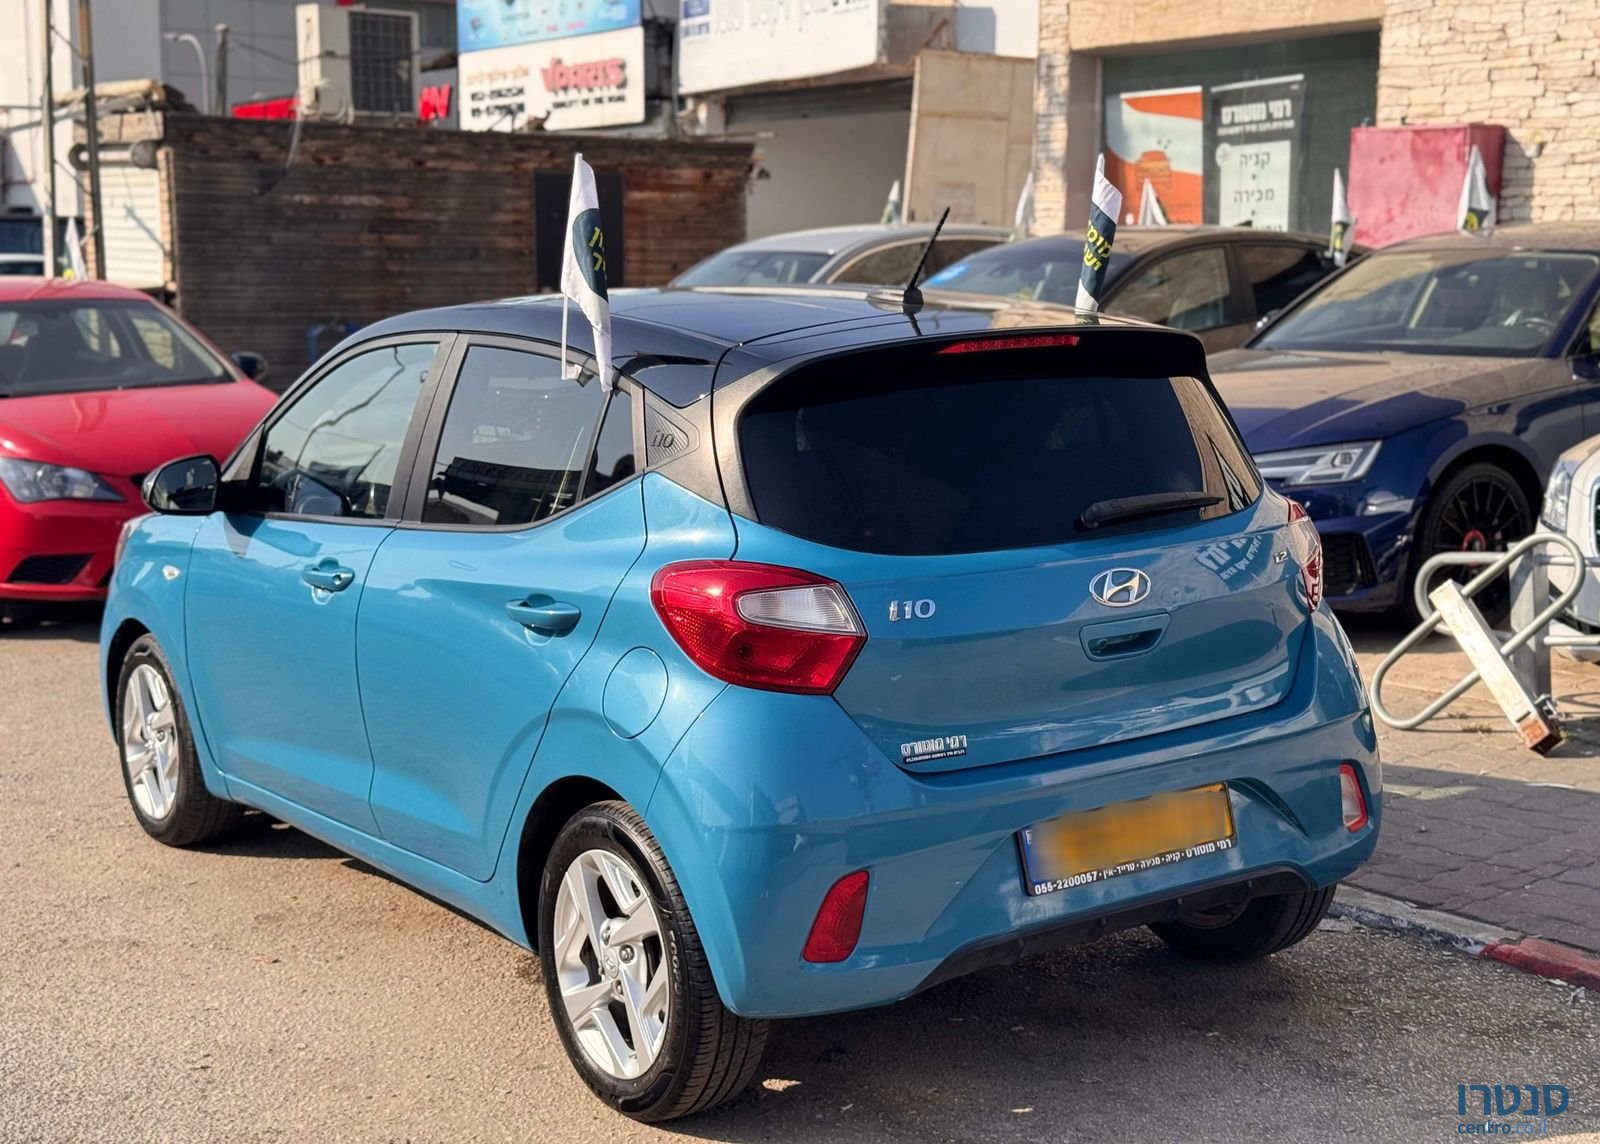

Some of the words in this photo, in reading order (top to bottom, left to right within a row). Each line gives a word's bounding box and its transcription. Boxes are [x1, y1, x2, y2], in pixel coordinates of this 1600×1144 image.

[1268, 99, 1291, 118] רמי
[1239, 152, 1271, 169] קניה
[1233, 188, 1274, 204] מכירה
[650, 429, 675, 448] i10
[888, 598, 936, 622] i10
[900, 737, 945, 757] מוטורס
[946, 734, 968, 749] רמי
[1186, 842, 1216, 858] מוטורס
[1216, 838, 1233, 850] רמי
[1139, 856, 1161, 869] מכירה
[1165, 851, 1181, 863] קניה
[1103, 862, 1136, 879] טרייד-אין
[1034, 871, 1098, 895] 055-2200057
